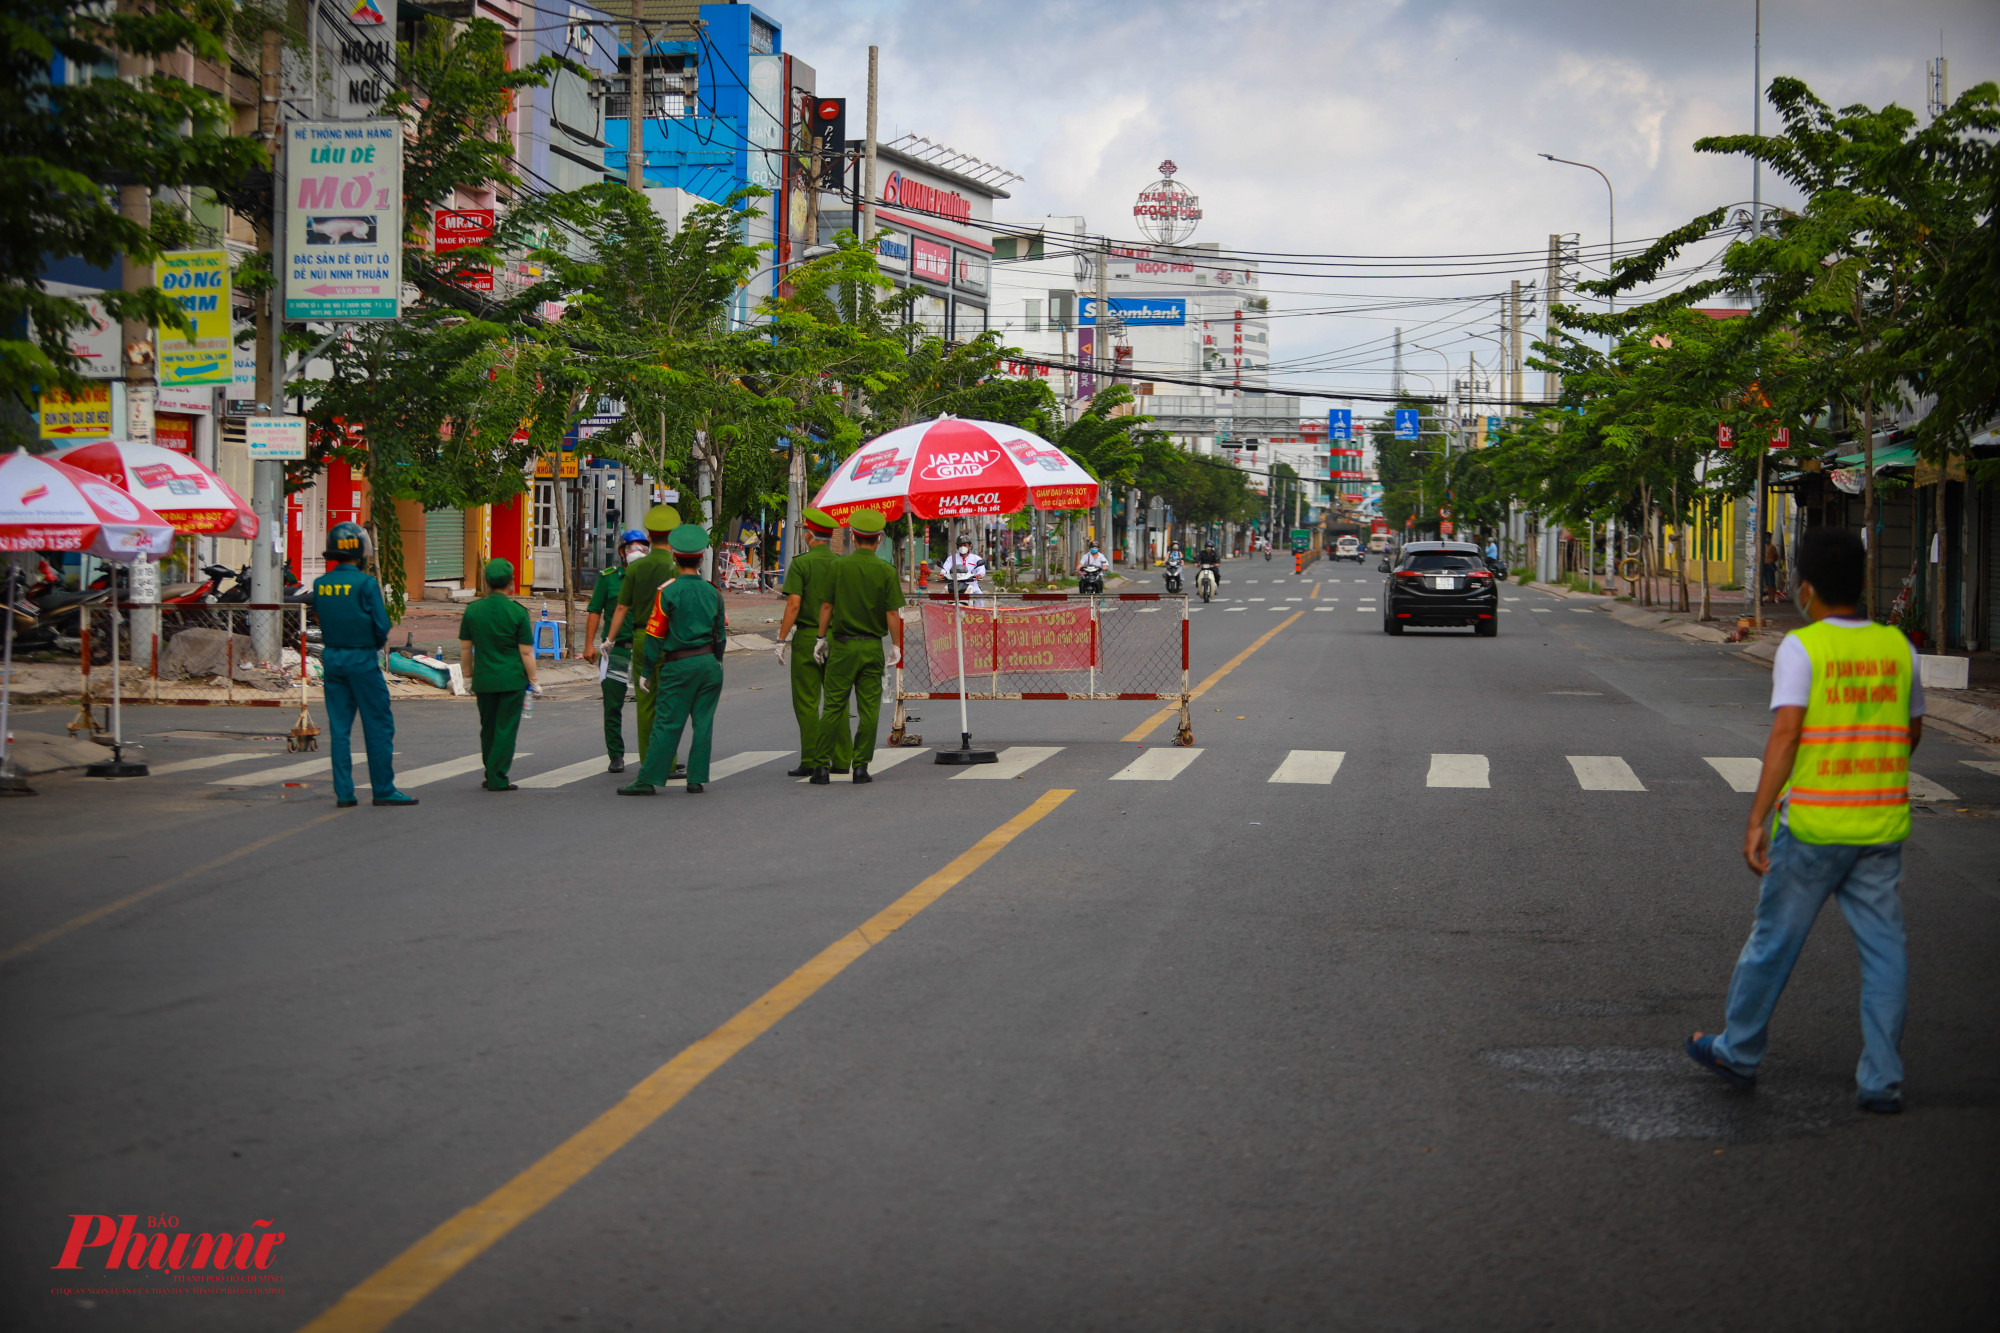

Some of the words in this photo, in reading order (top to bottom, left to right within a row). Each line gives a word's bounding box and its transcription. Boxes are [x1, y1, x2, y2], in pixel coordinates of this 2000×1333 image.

[437, 236, 456, 245] MADE
[458, 236, 466, 244] IN
[880, 238, 907, 262] SUZUKI
[330, 269, 353, 280] NINH
[1084, 302, 1181, 319] Scombank
[927, 450, 989, 468] JAPAN
[940, 465, 980, 476] GMP
[938, 492, 1001, 508] HAPACOL
[11, 537, 46, 549] 1900
[47, 536, 82, 548] 1565
[318, 584, 353, 596] DQTT
